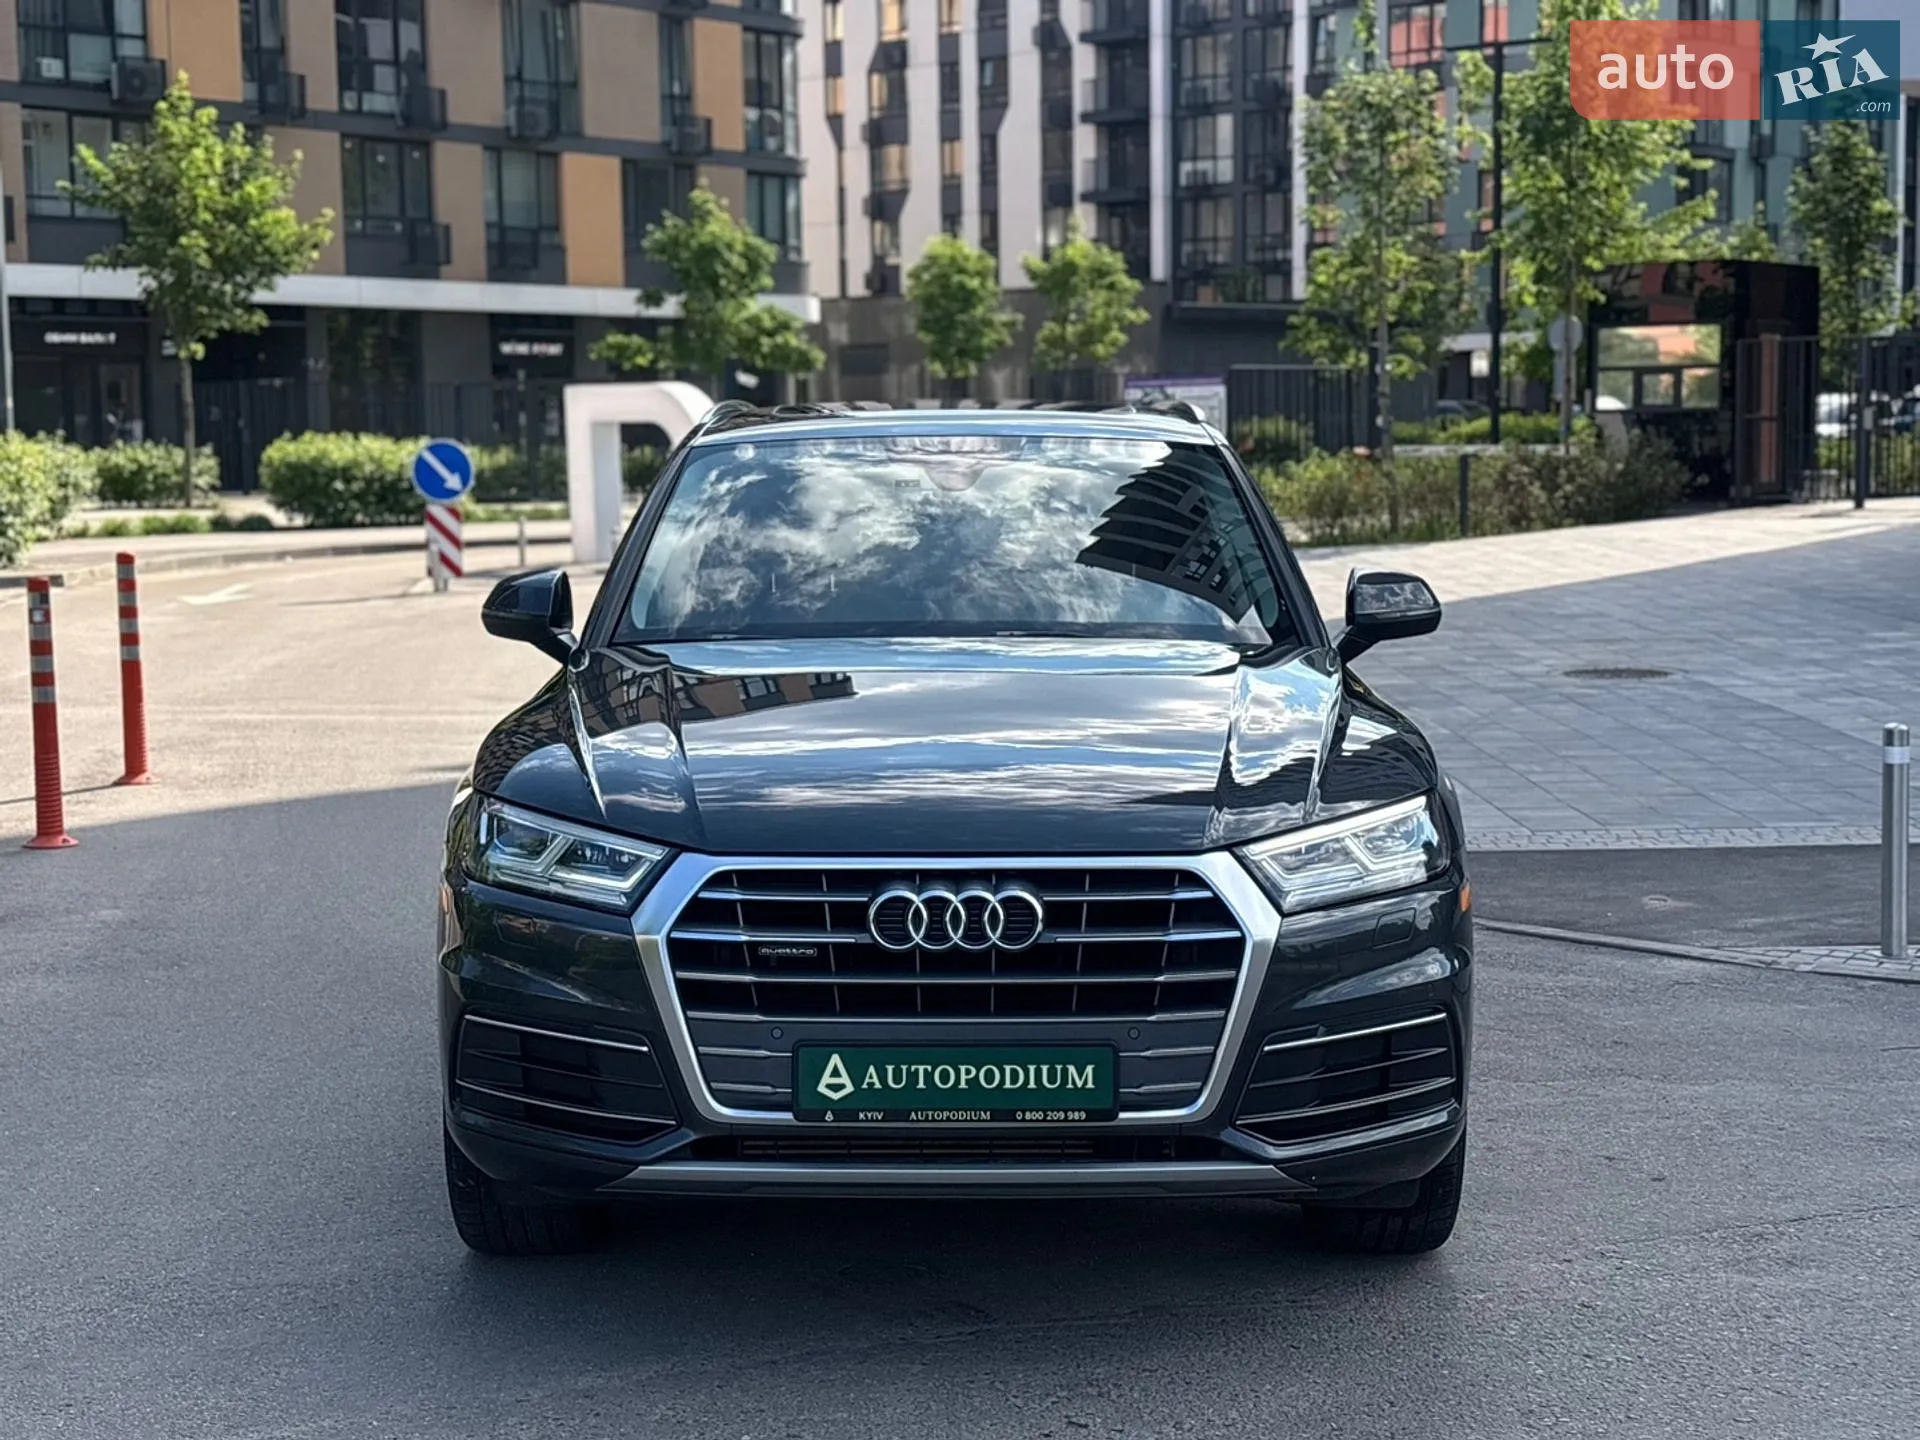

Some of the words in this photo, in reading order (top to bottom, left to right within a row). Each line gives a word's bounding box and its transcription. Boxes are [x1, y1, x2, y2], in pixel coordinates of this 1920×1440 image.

[761, 947, 815, 955] quattro
[861, 1064, 1095, 1089] AUTOPODIUM
[858, 1111, 884, 1121] KYIV
[909, 1110, 991, 1121] AUTOPODIUM
[1015, 1110, 1023, 1121] 0
[1024, 1110, 1044, 1121] 800
[1046, 1110, 1065, 1121] 209
[1067, 1110, 1087, 1121] 989
